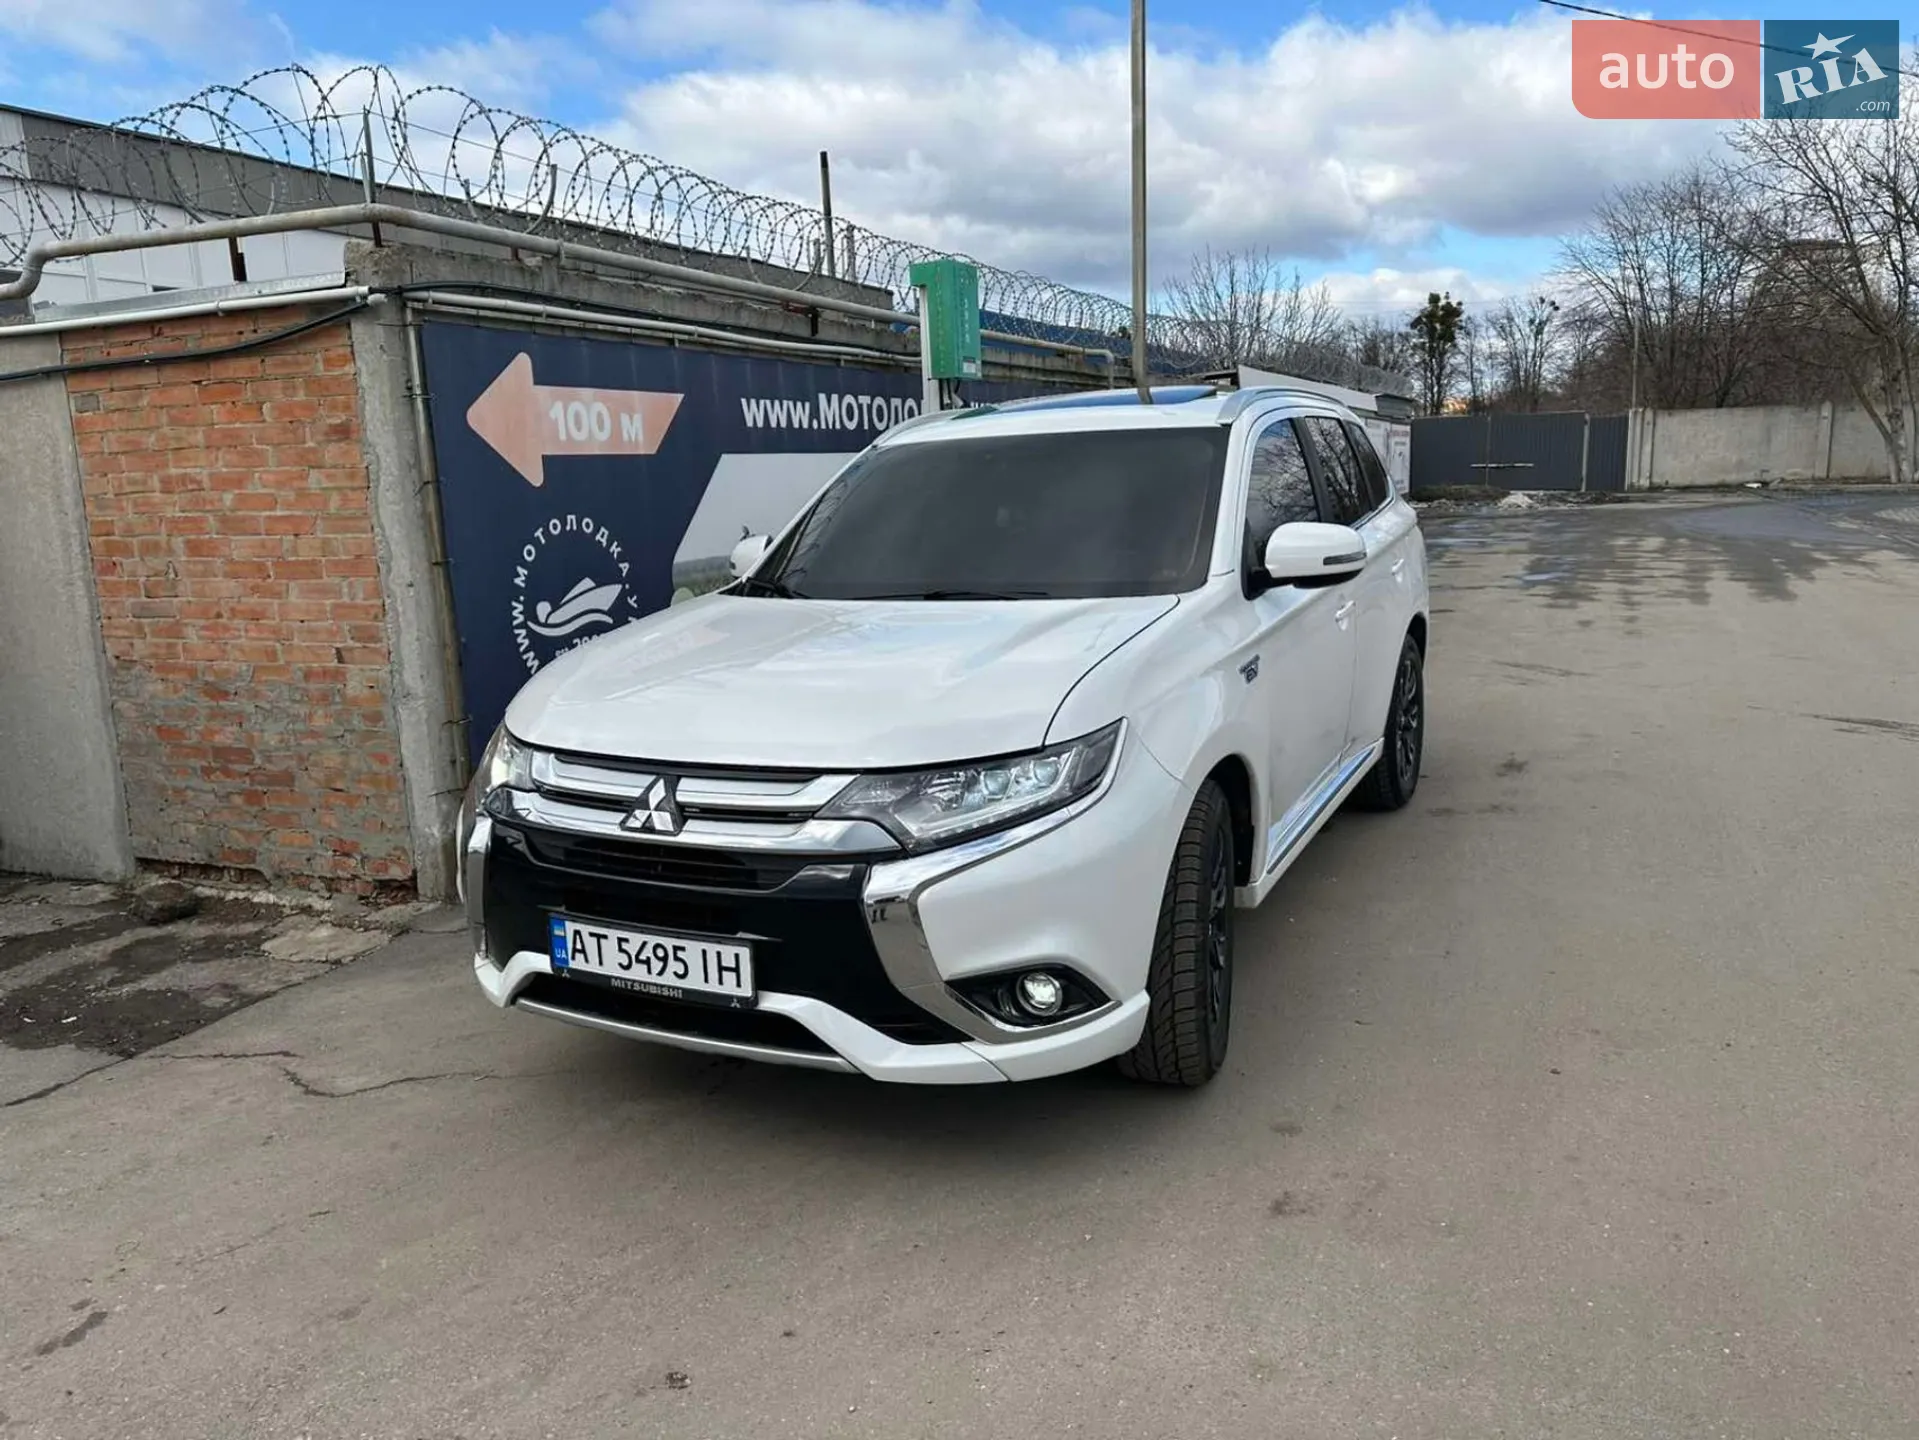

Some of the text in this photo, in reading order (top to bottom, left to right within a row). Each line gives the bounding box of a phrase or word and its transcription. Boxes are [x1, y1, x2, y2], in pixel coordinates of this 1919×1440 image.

[549, 400, 612, 442] 100
[555, 928, 743, 989] UA AT 5495 IH
[610, 977, 684, 999] MITSUBISHI
